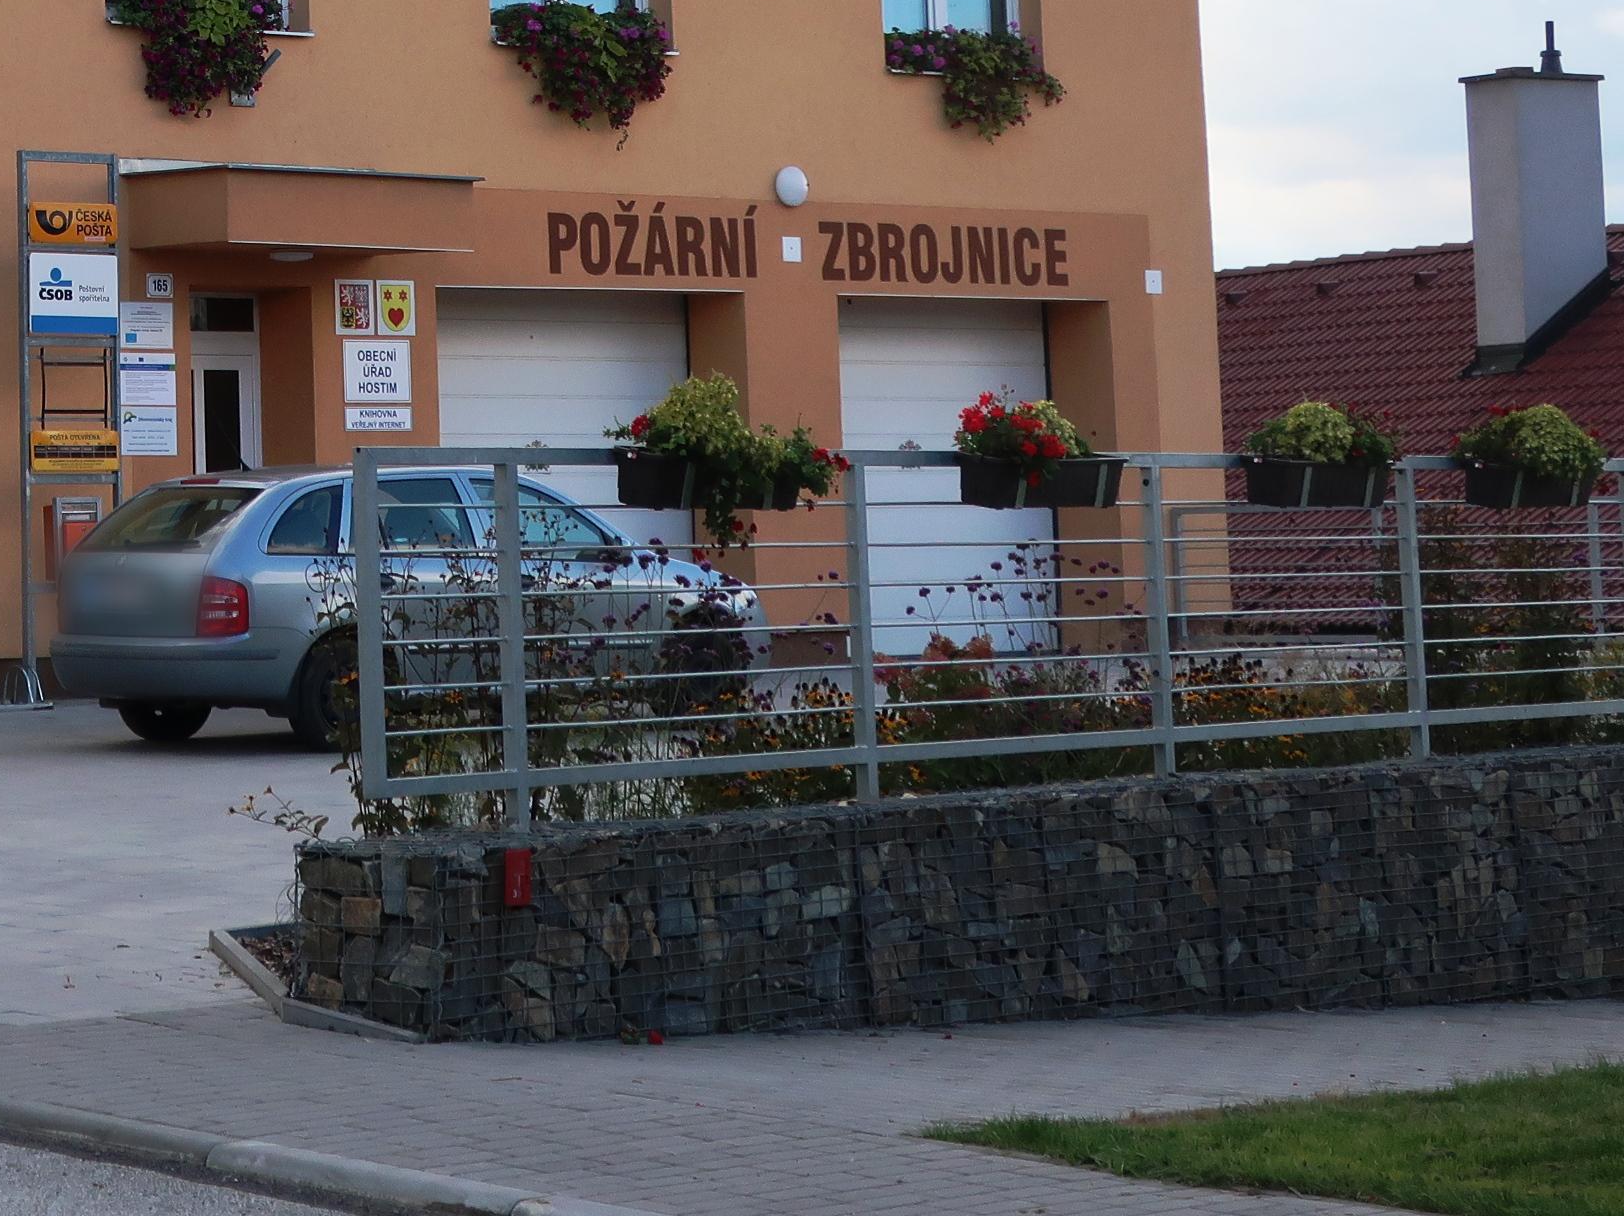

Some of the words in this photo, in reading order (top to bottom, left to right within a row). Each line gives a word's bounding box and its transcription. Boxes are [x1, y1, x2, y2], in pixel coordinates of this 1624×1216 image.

[76, 208, 112, 222] ČESKÁ
[76, 223, 113, 237] POŠTA
[547, 200, 758, 278] POŽÁRNÍ
[818, 221, 1069, 287] ZBROJNICE
[78, 285, 105, 293] Poštovní
[152, 278, 168, 293] 165
[39, 287, 73, 301] ČSOB
[78, 295, 110, 303] spořitelna
[357, 348, 397, 362] OBECNÍ
[362, 364, 392, 378] ÚŘAD
[358, 382, 397, 394] HOSTIM
[359, 409, 398, 418] KNIHOVNA
[351, 420, 377, 429] VEŘEJNÝ
[378, 421, 406, 429] INTERNET
